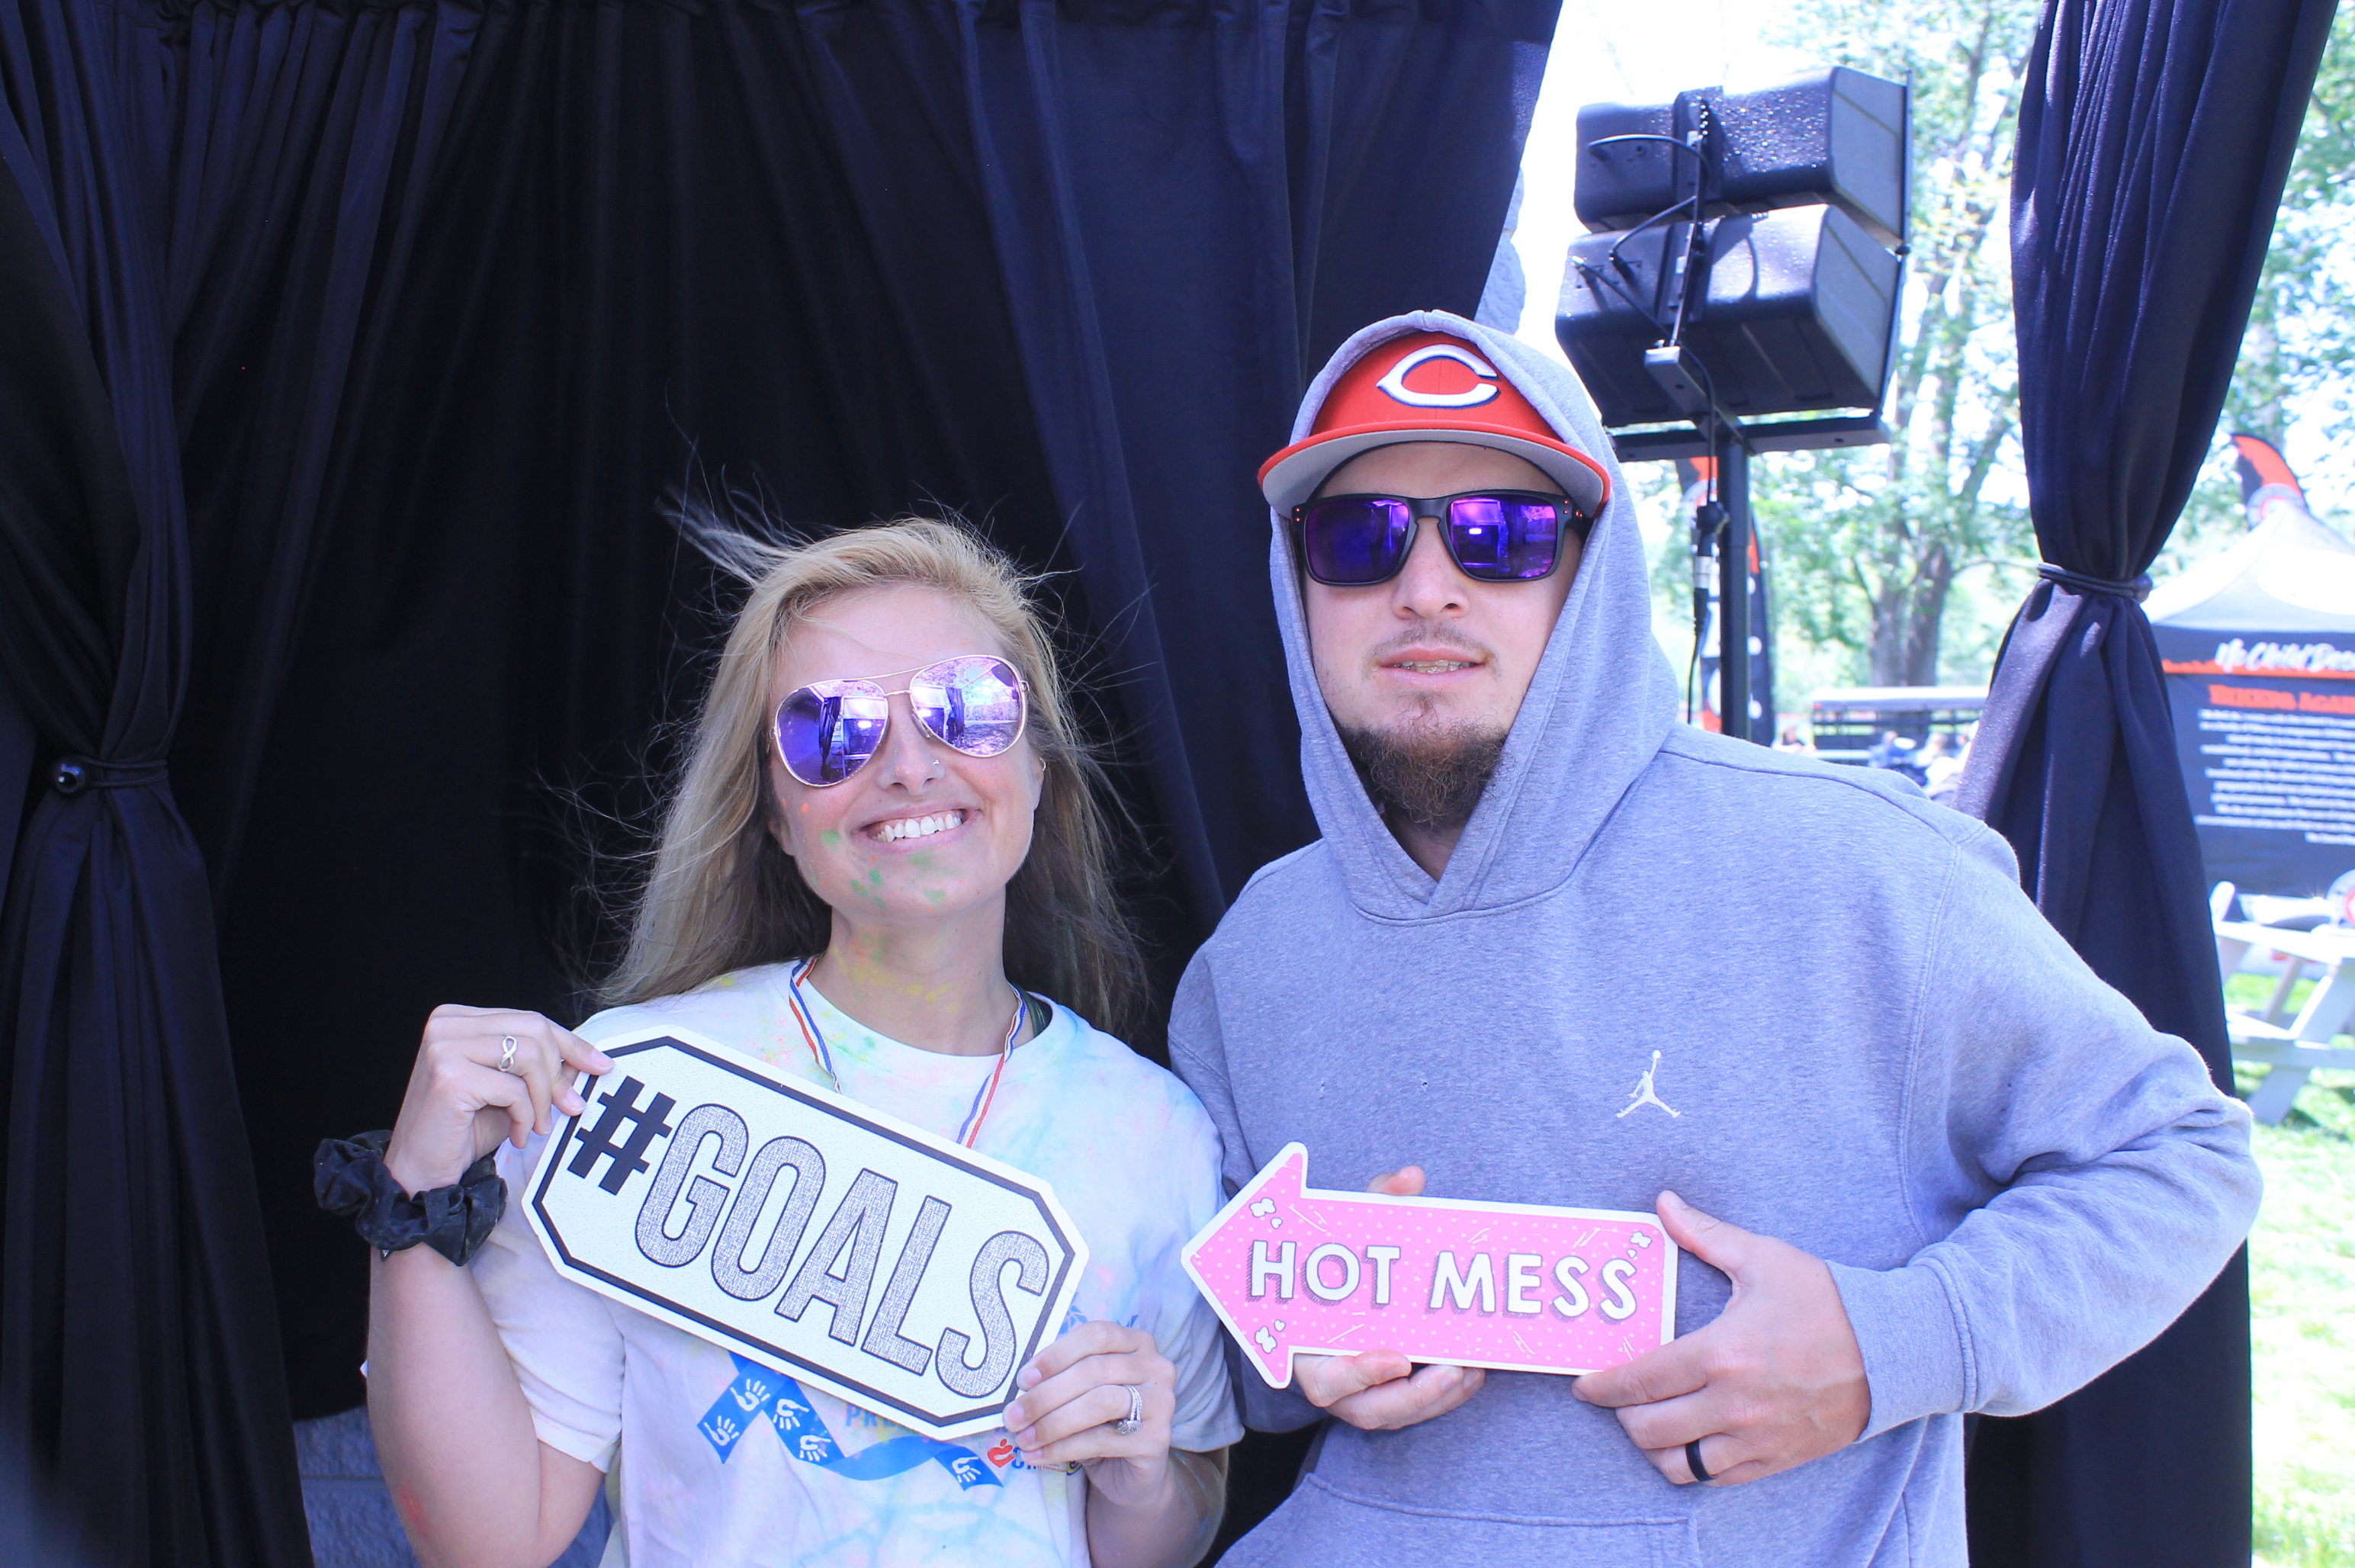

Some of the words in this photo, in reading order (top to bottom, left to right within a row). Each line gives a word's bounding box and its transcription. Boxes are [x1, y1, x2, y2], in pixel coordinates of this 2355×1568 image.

[1375, 343, 1502, 410] C
[567, 1076, 1049, 1398] #GOALS
[1247, 1239, 1401, 1307] HOT
[1425, 1250, 1637, 1321] MESS
